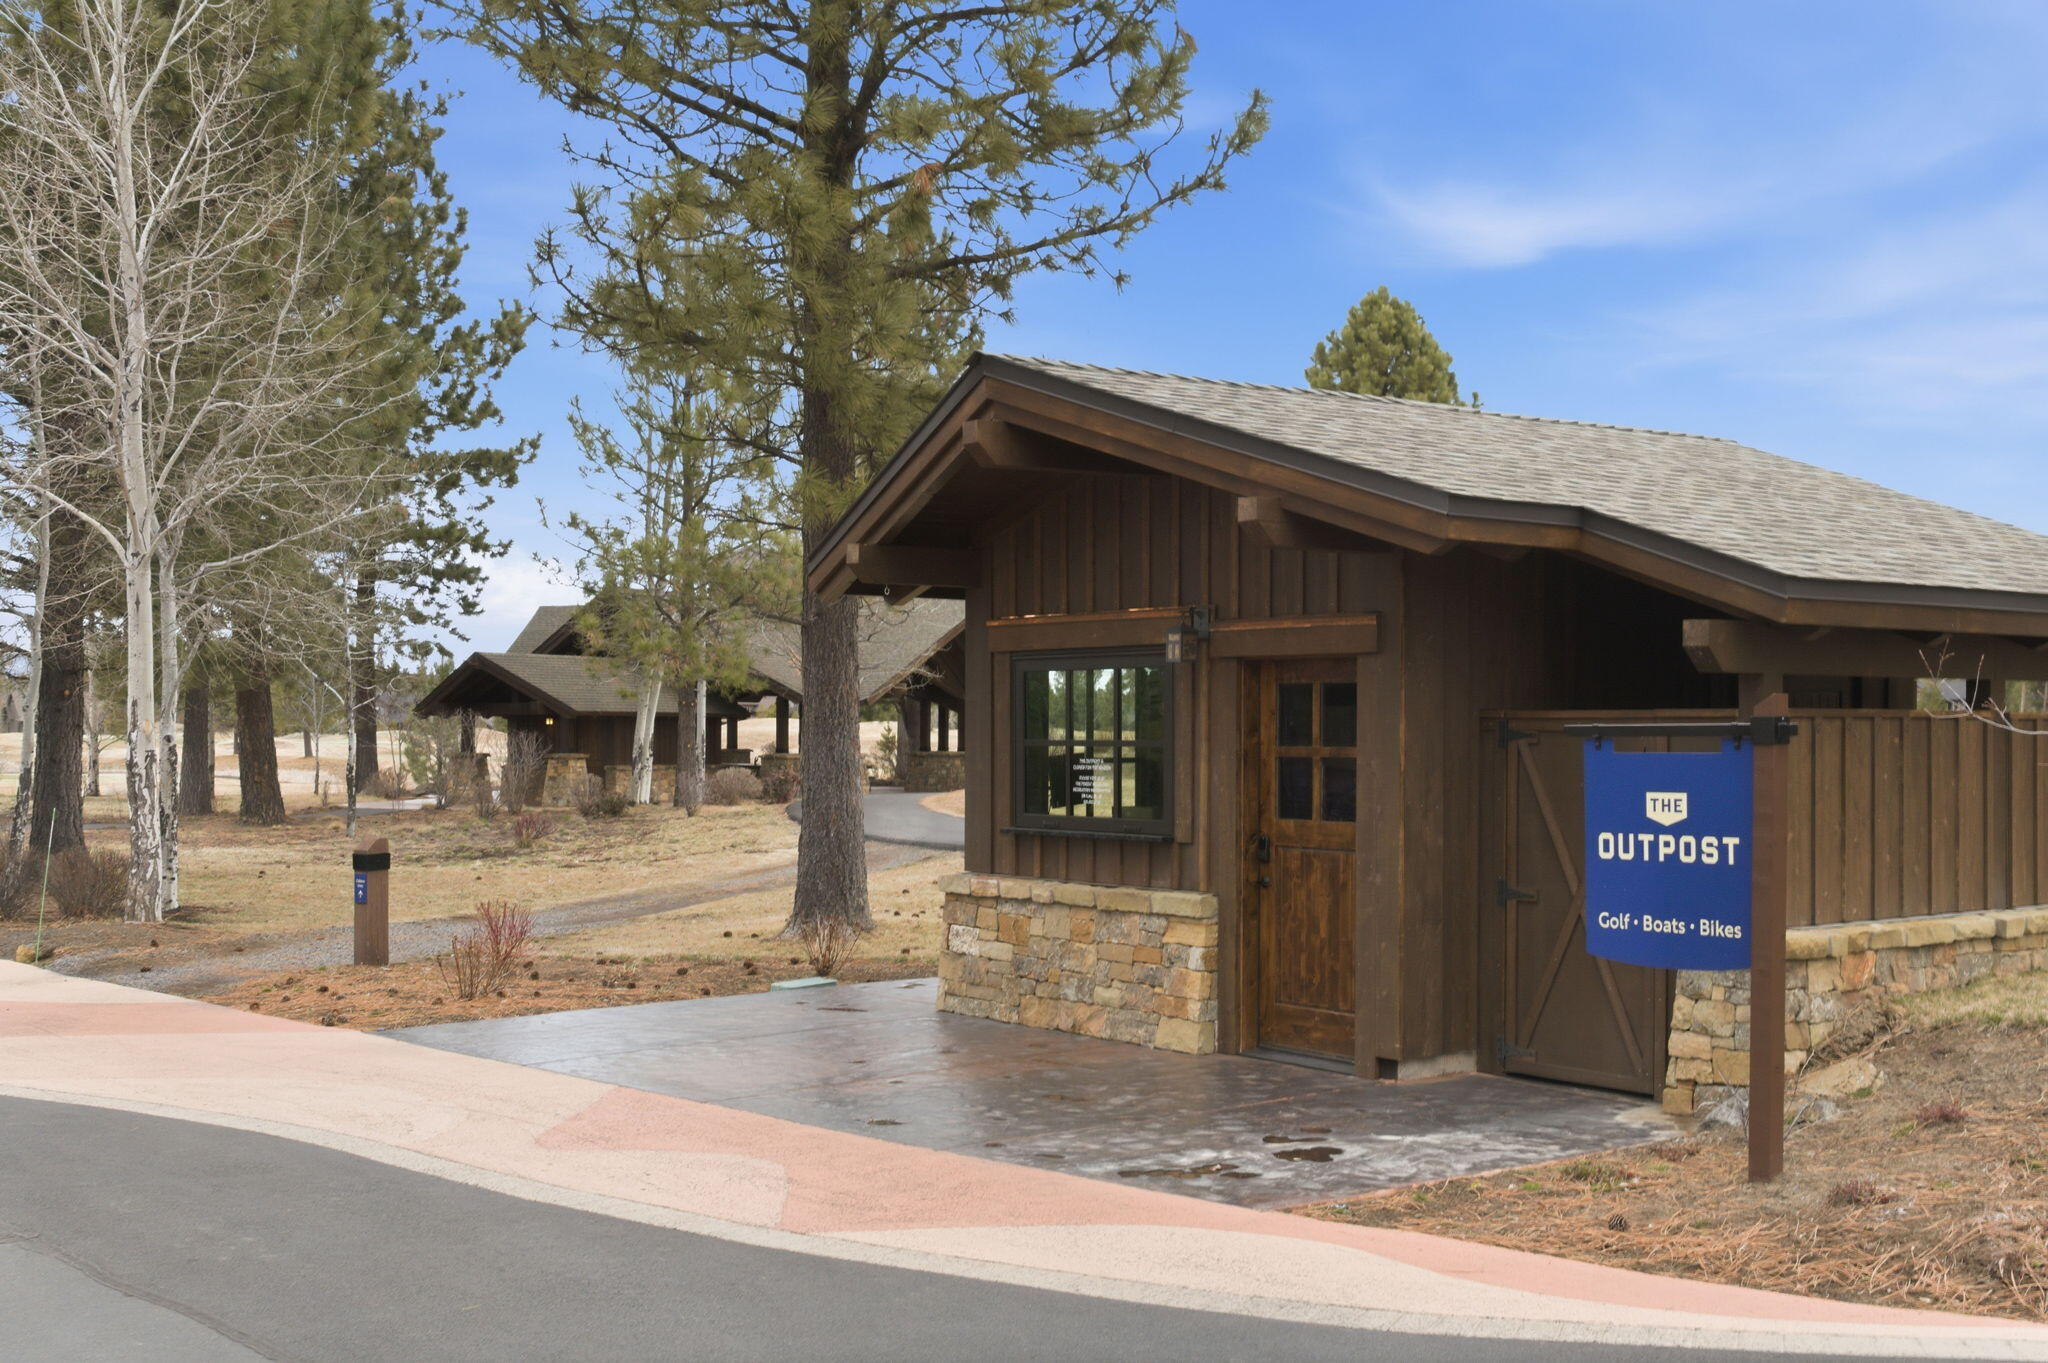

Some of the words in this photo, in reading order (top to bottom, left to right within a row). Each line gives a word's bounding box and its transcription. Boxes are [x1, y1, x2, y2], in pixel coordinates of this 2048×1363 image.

[1650, 798, 1683, 813] THE
[1598, 831, 1740, 865] OUTPOST
[1598, 911, 1631, 930] Golf
[1642, 915, 1686, 935] Boats
[1699, 919, 1742, 939] Bikes
